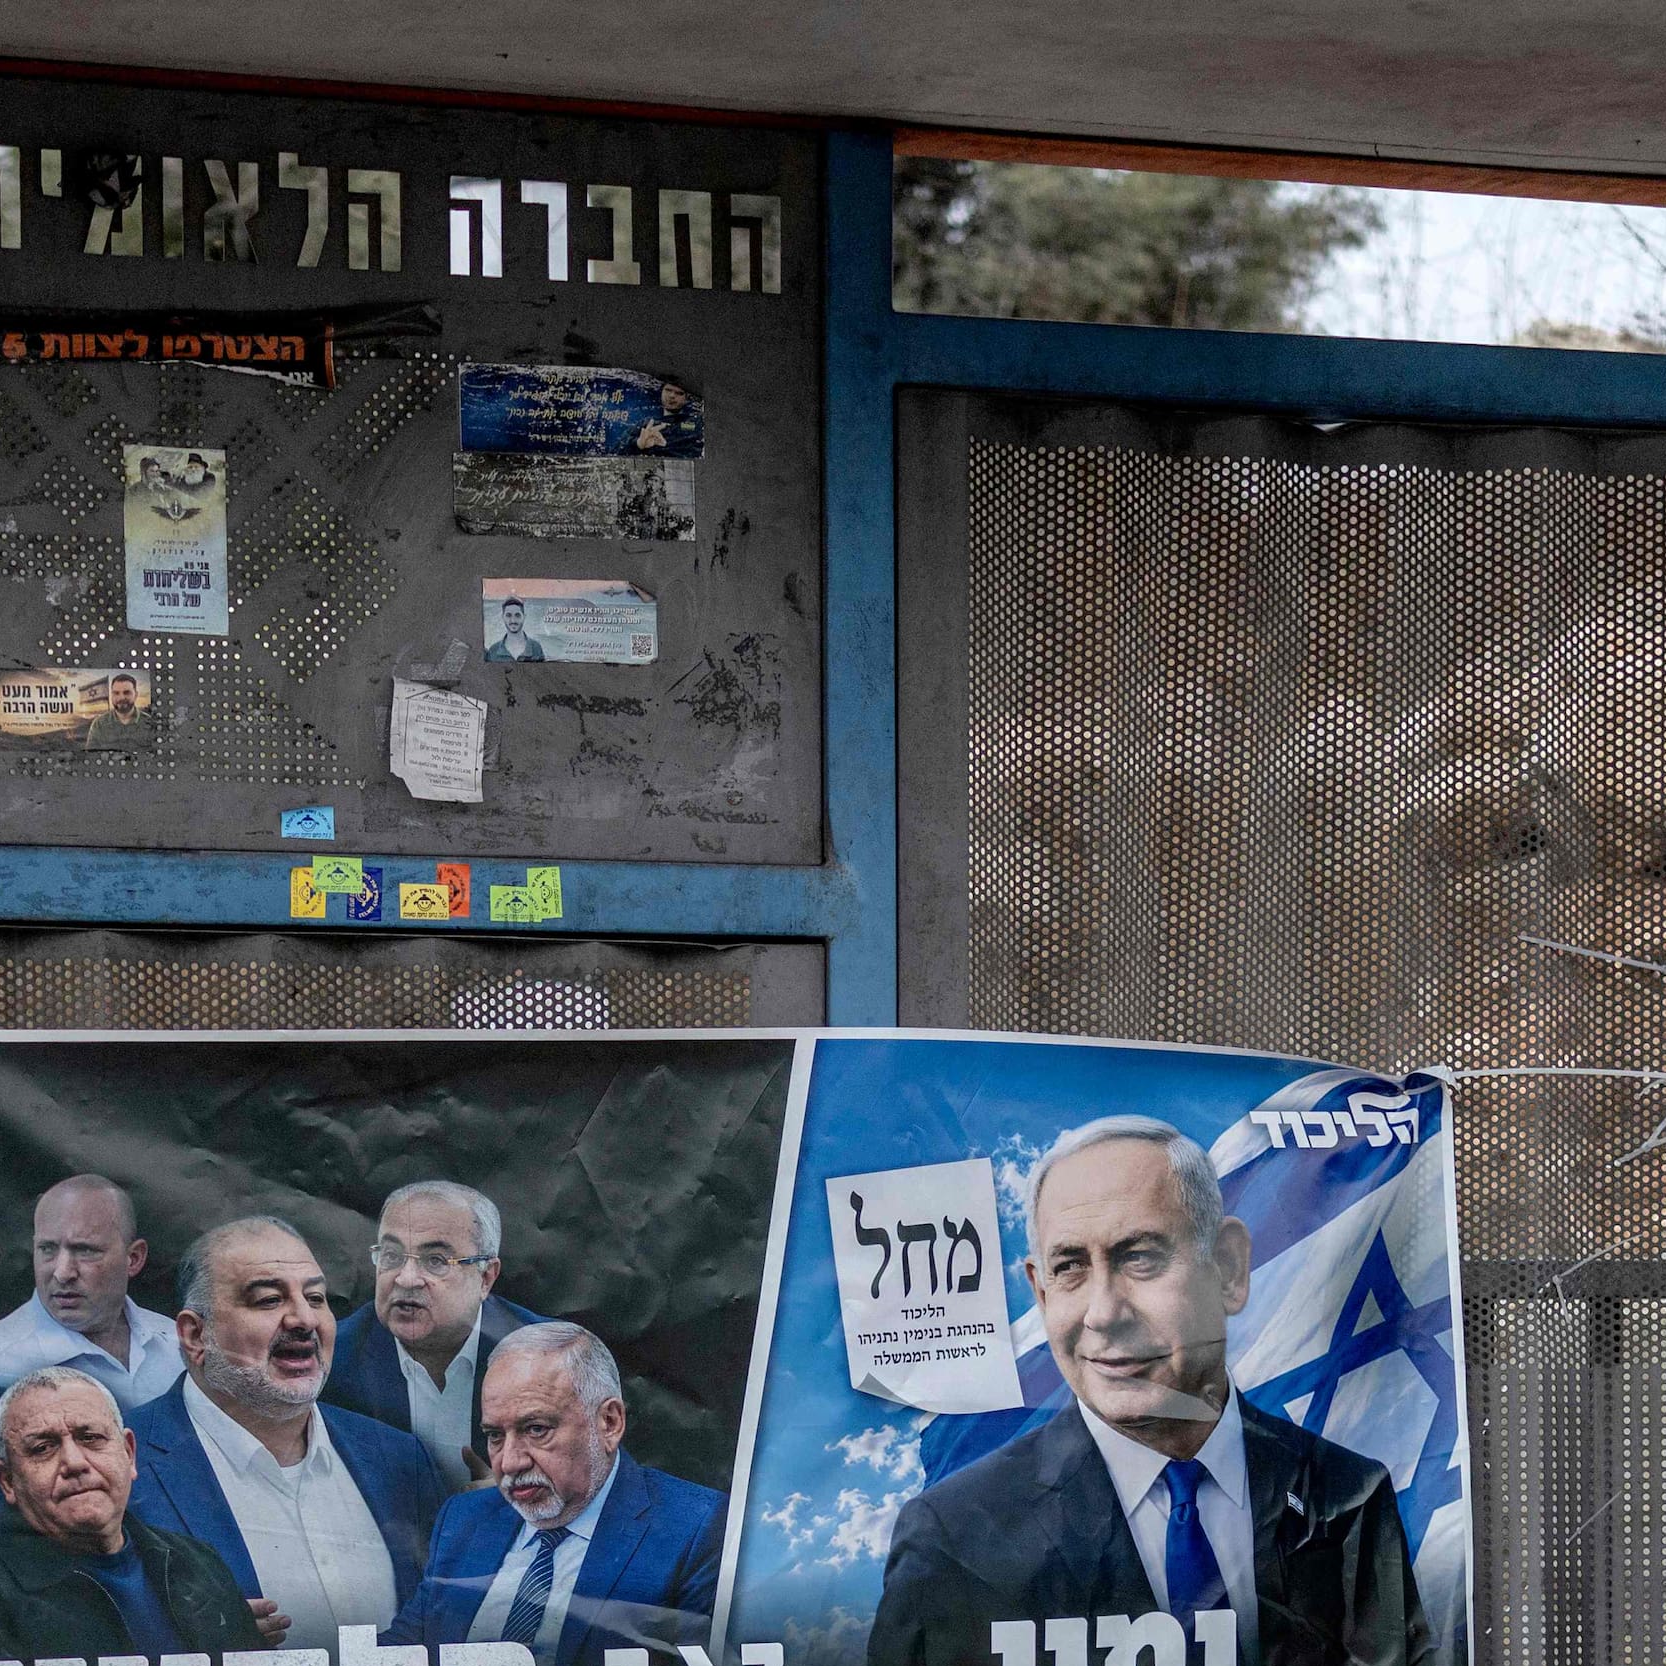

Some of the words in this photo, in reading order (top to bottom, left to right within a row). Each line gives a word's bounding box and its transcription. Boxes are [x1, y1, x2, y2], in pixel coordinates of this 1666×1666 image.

[447, 173, 783, 294] החברה
[2, 331, 28, 360] 6
[39, 327, 149, 360] לצוות
[161, 333, 306, 362] הצטרפו
[143, 567, 211, 590] בשליחות
[153, 591, 180, 607] הרבי
[182, 590, 201, 607] של
[2, 685, 31, 698] מעט
[39, 701, 74, 714] ועשה
[1249, 1092, 1421, 1150] הליכוד
[849, 1190, 983, 1300] מחל
[900, 1303, 946, 1321] הליכוד
[857, 1330, 899, 1346] נתניהו
[903, 1326, 943, 1345] בנימין
[946, 1321, 996, 1338] בהנהגת
[873, 1349, 932, 1367] הממשלה
[935, 1342, 987, 1361] לראשות
